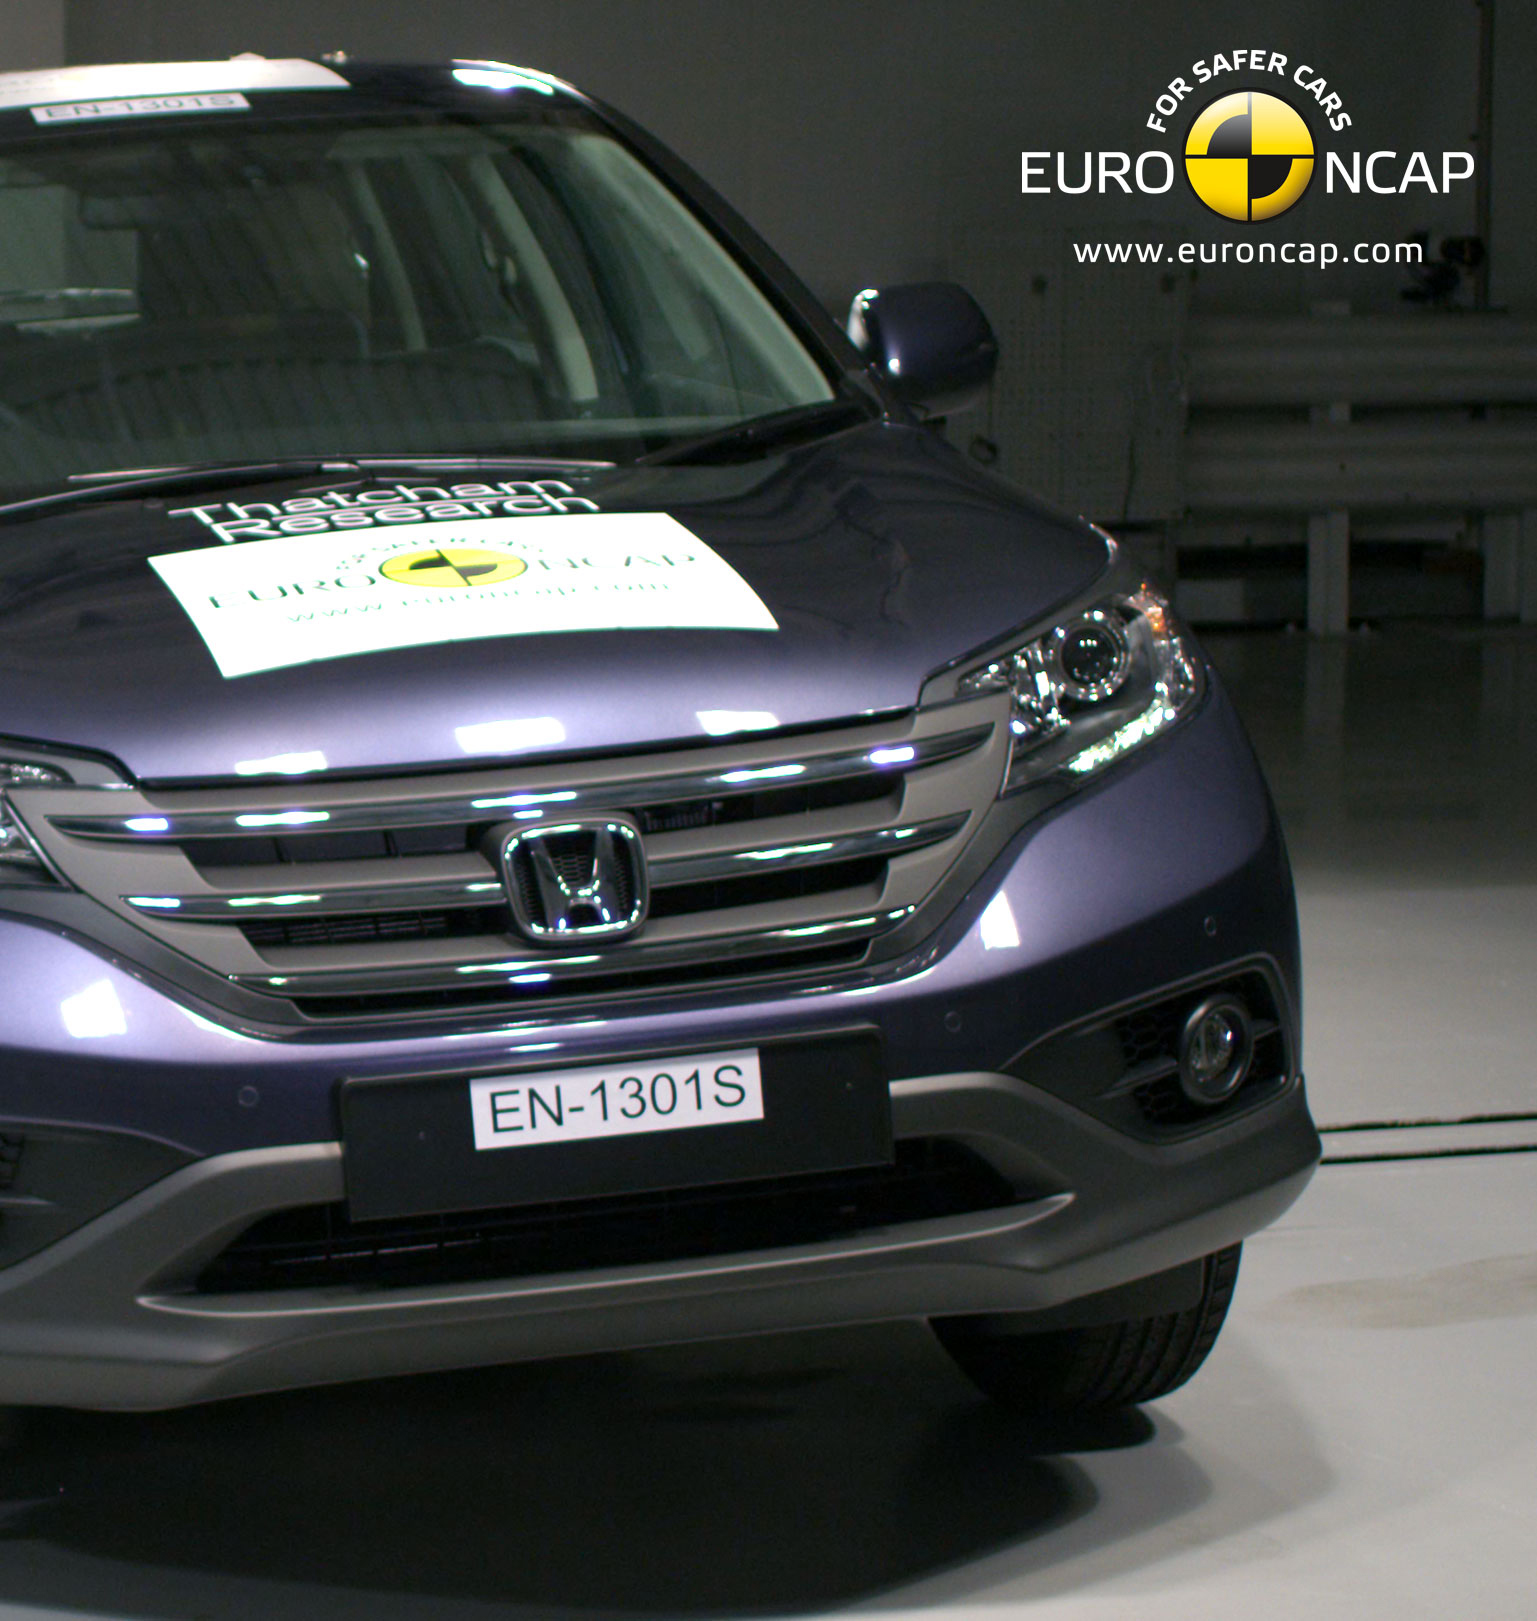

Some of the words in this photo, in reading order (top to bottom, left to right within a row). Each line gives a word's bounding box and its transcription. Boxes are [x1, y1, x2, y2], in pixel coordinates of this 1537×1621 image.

[44, 95, 235, 119] EN-1301S
[168, 480, 575, 525] Thatcham
[211, 493, 600, 543] Research
[488, 1064, 747, 1134] EN-1301S
